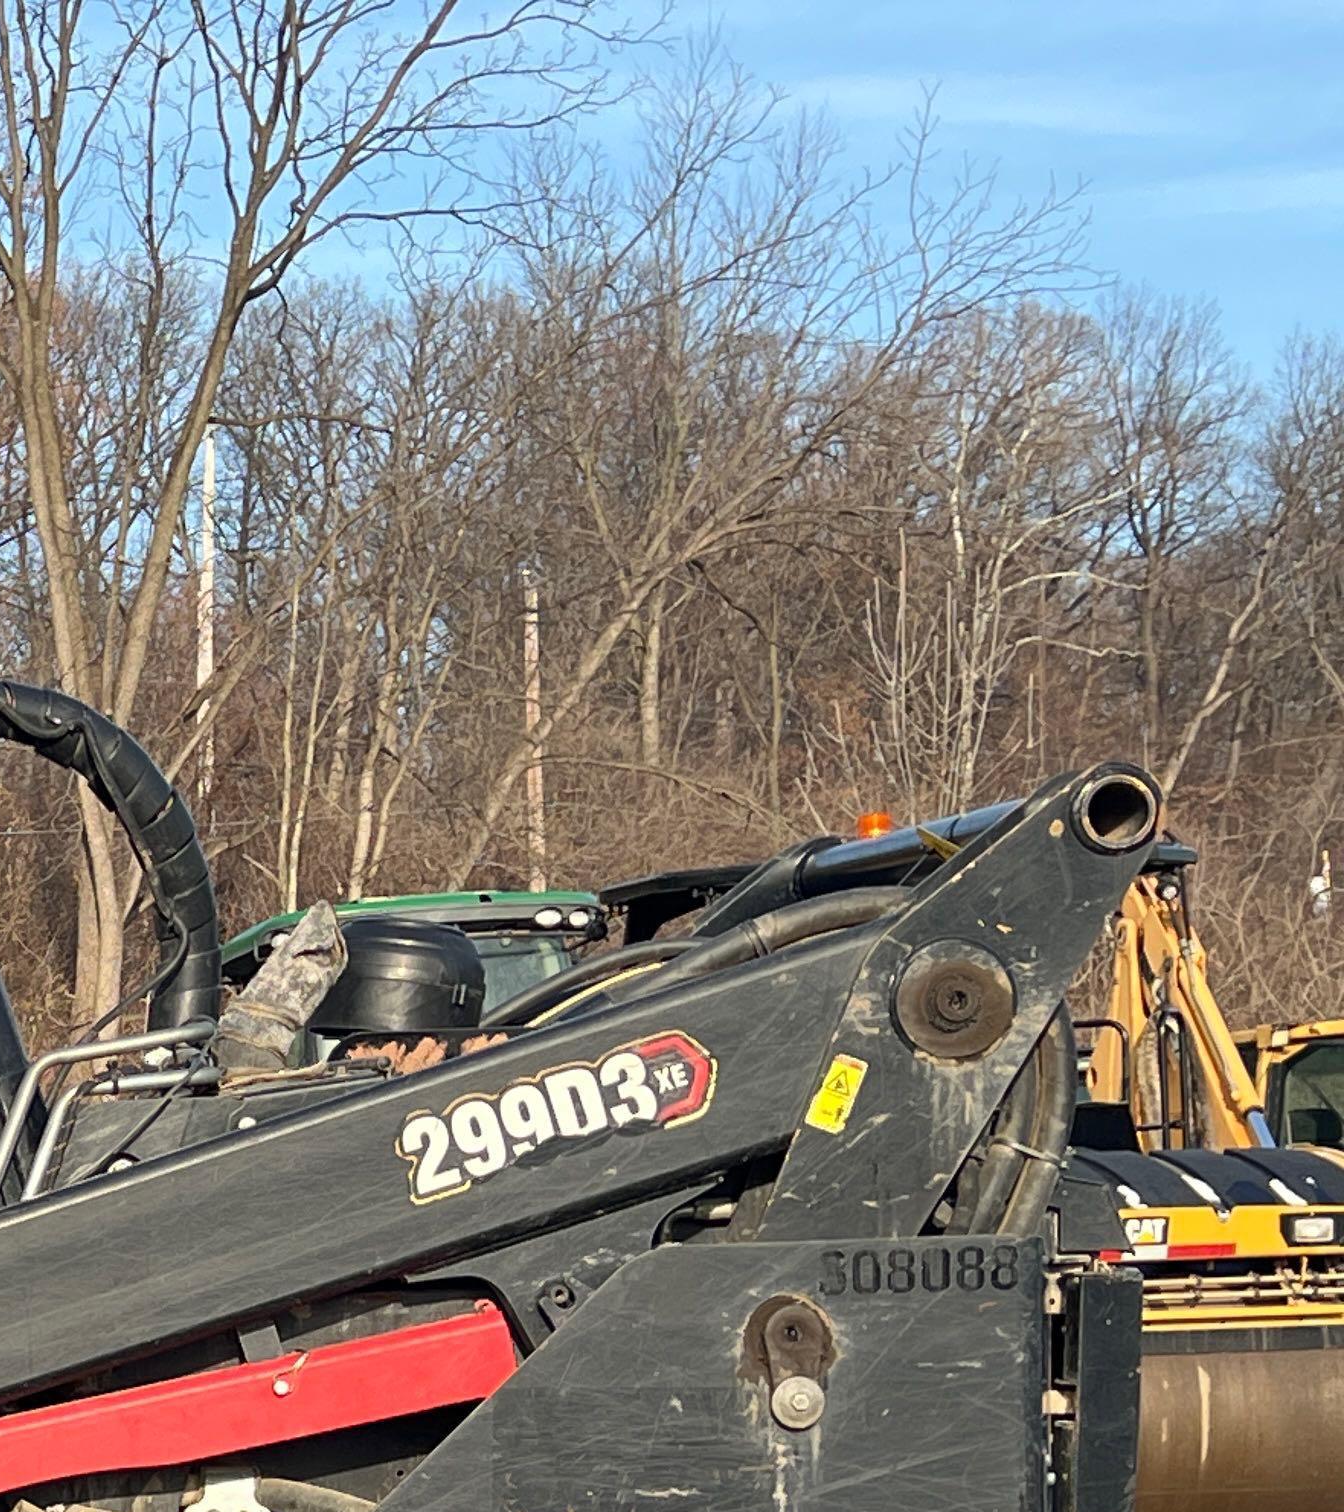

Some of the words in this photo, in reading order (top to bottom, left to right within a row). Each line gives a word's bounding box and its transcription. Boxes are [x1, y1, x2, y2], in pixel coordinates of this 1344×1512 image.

[402, 1052, 657, 1195] 299D3
[653, 1063, 688, 1094] XE
[1125, 1218, 1167, 1244] CAT
